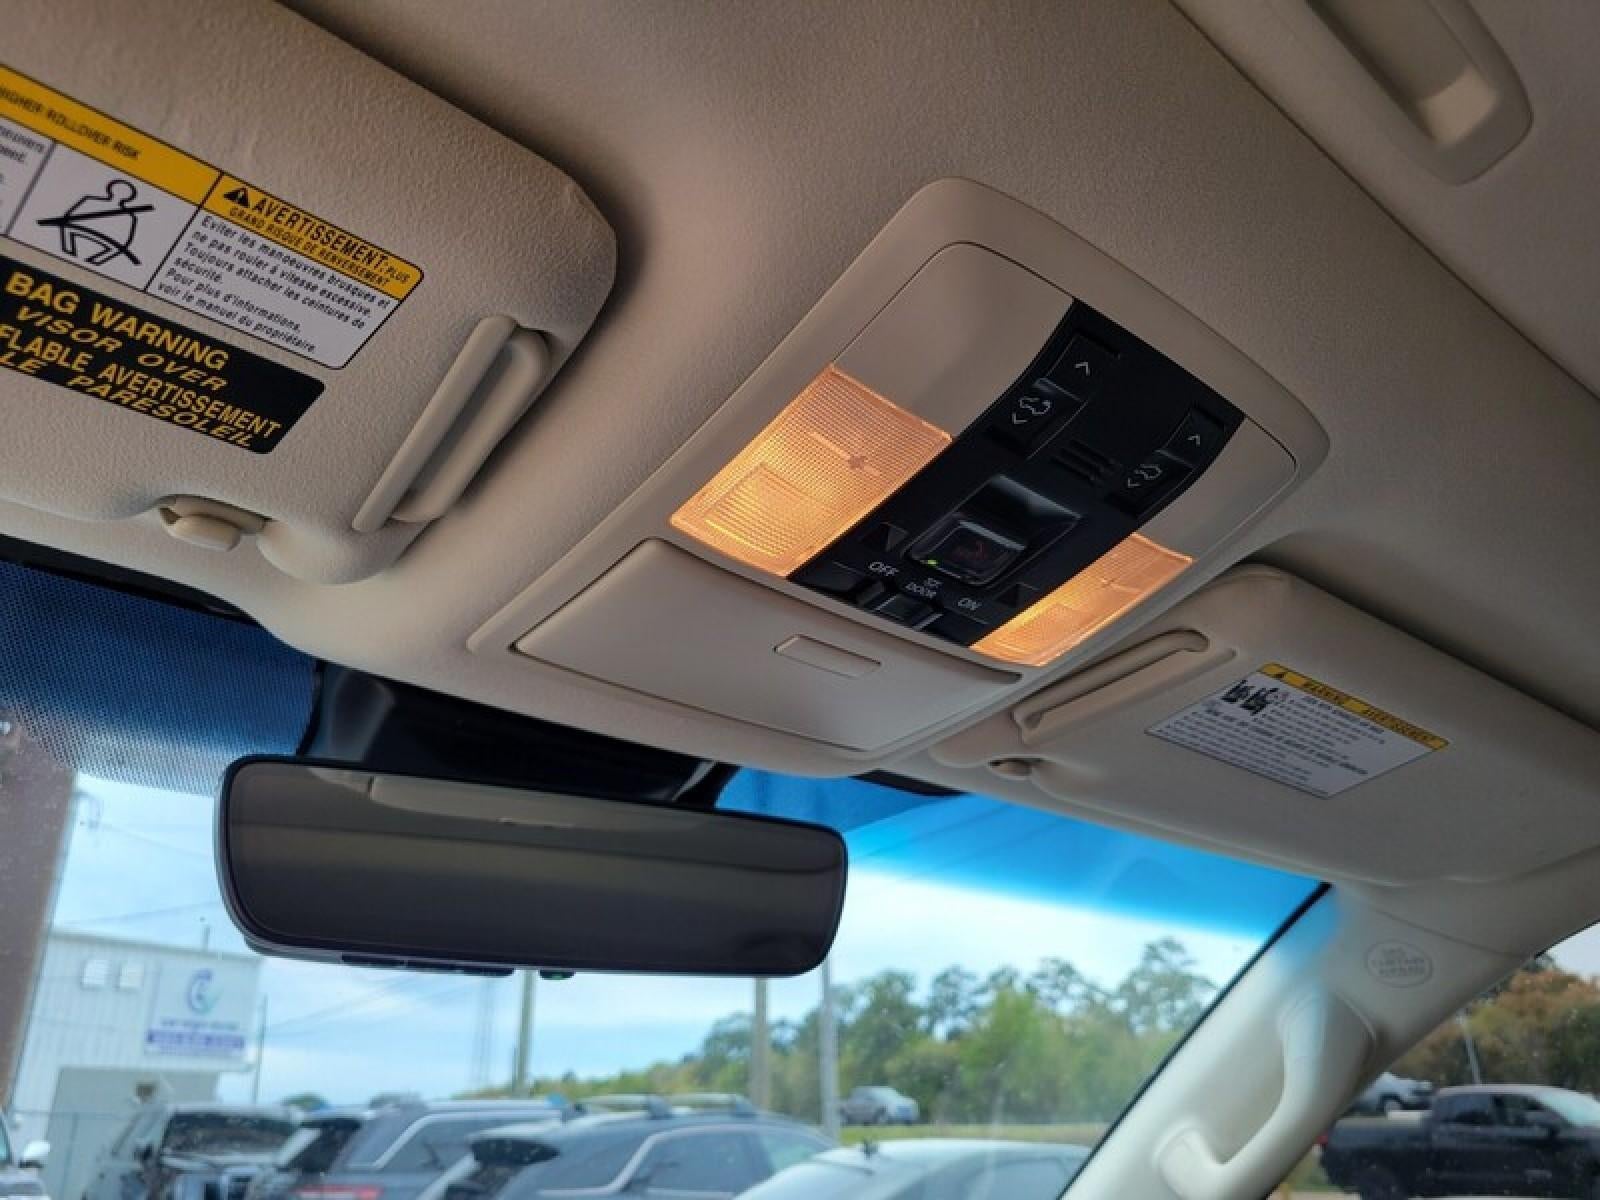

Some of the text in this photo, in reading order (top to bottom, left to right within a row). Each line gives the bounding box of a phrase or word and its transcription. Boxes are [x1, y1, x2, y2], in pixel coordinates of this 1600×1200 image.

[166, 267, 195, 286] Pour
[194, 279, 221, 299] plus
[183, 241, 366, 330] Toujours attacher les ceintures de
[192, 230, 208, 244] ne
[207, 239, 231, 256] pas
[233, 248, 270, 272] rouler
[279, 268, 319, 293] vitesse
[239, 234, 257, 249] les
[327, 273, 377, 303] brusques
[377, 299, 391, 310] et
[5, 271, 230, 371] BAG WARNING
[157, 281, 182, 297] voir
[182, 290, 195, 303] le
[195, 297, 239, 321] manuel
[237, 313, 253, 328] du
[16, 305, 229, 391] VISOR OVER
[66, 374, 253, 448] PARESOLEIL
[97, 362, 283, 439] AVERTISSEMENT
[867, 561, 899, 577] OFF
[957, 597, 982, 611] ON
